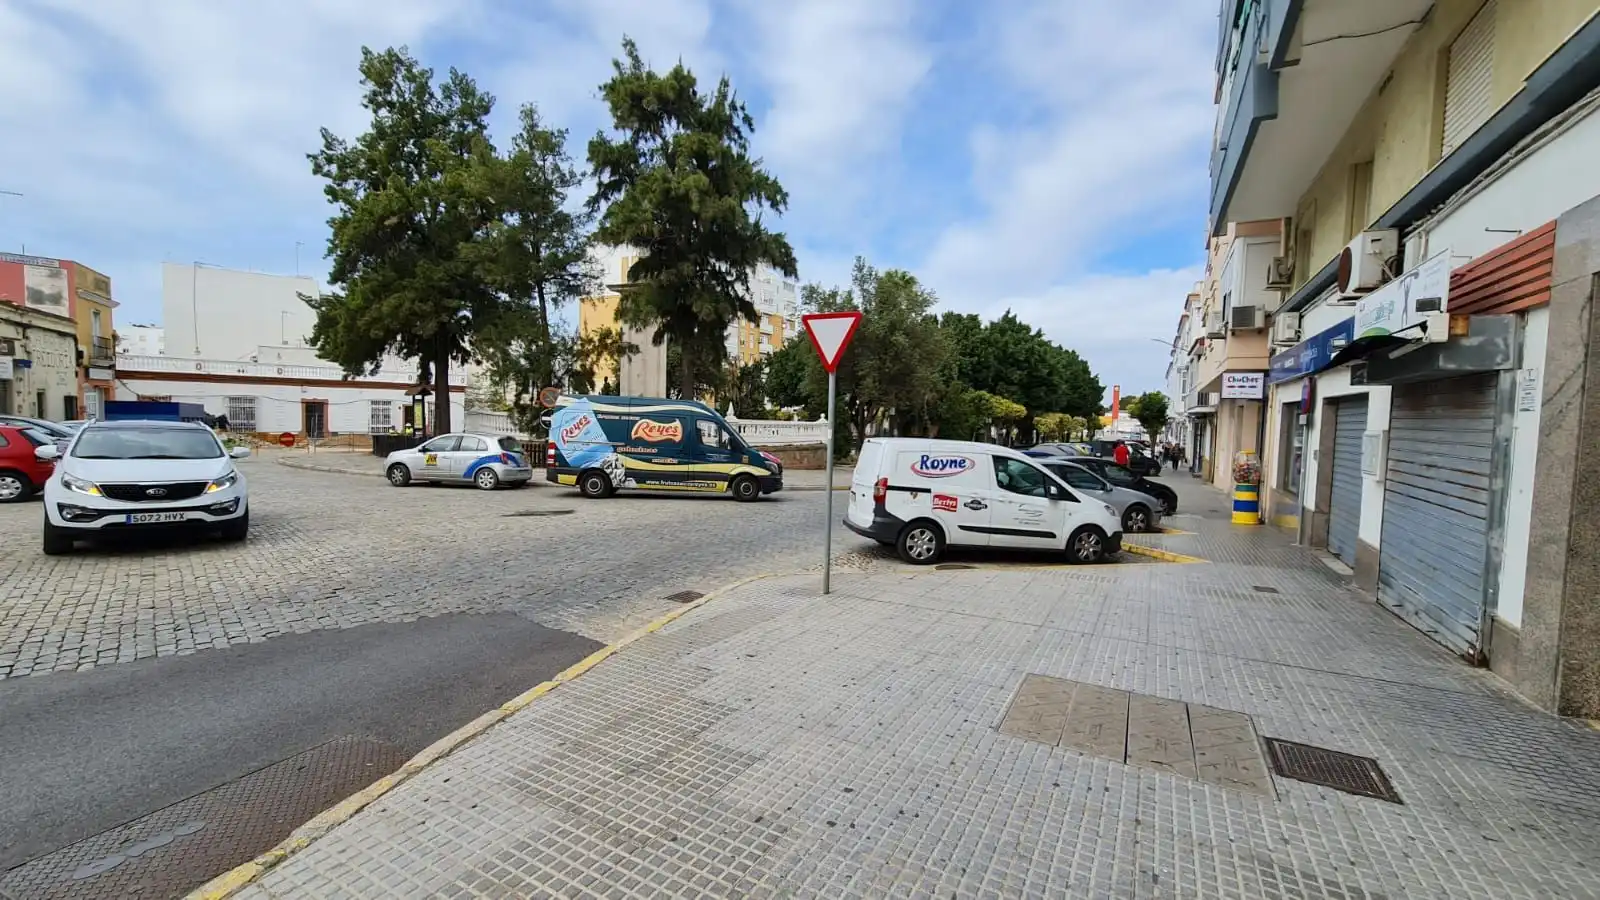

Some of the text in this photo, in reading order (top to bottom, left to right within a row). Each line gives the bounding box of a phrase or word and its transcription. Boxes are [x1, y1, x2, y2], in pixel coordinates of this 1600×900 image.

[562, 415, 591, 445] Reyes
[634, 420, 680, 438] Reyes
[920, 455, 966, 471] Royne
[133, 513, 185, 523] 5072 HVX
